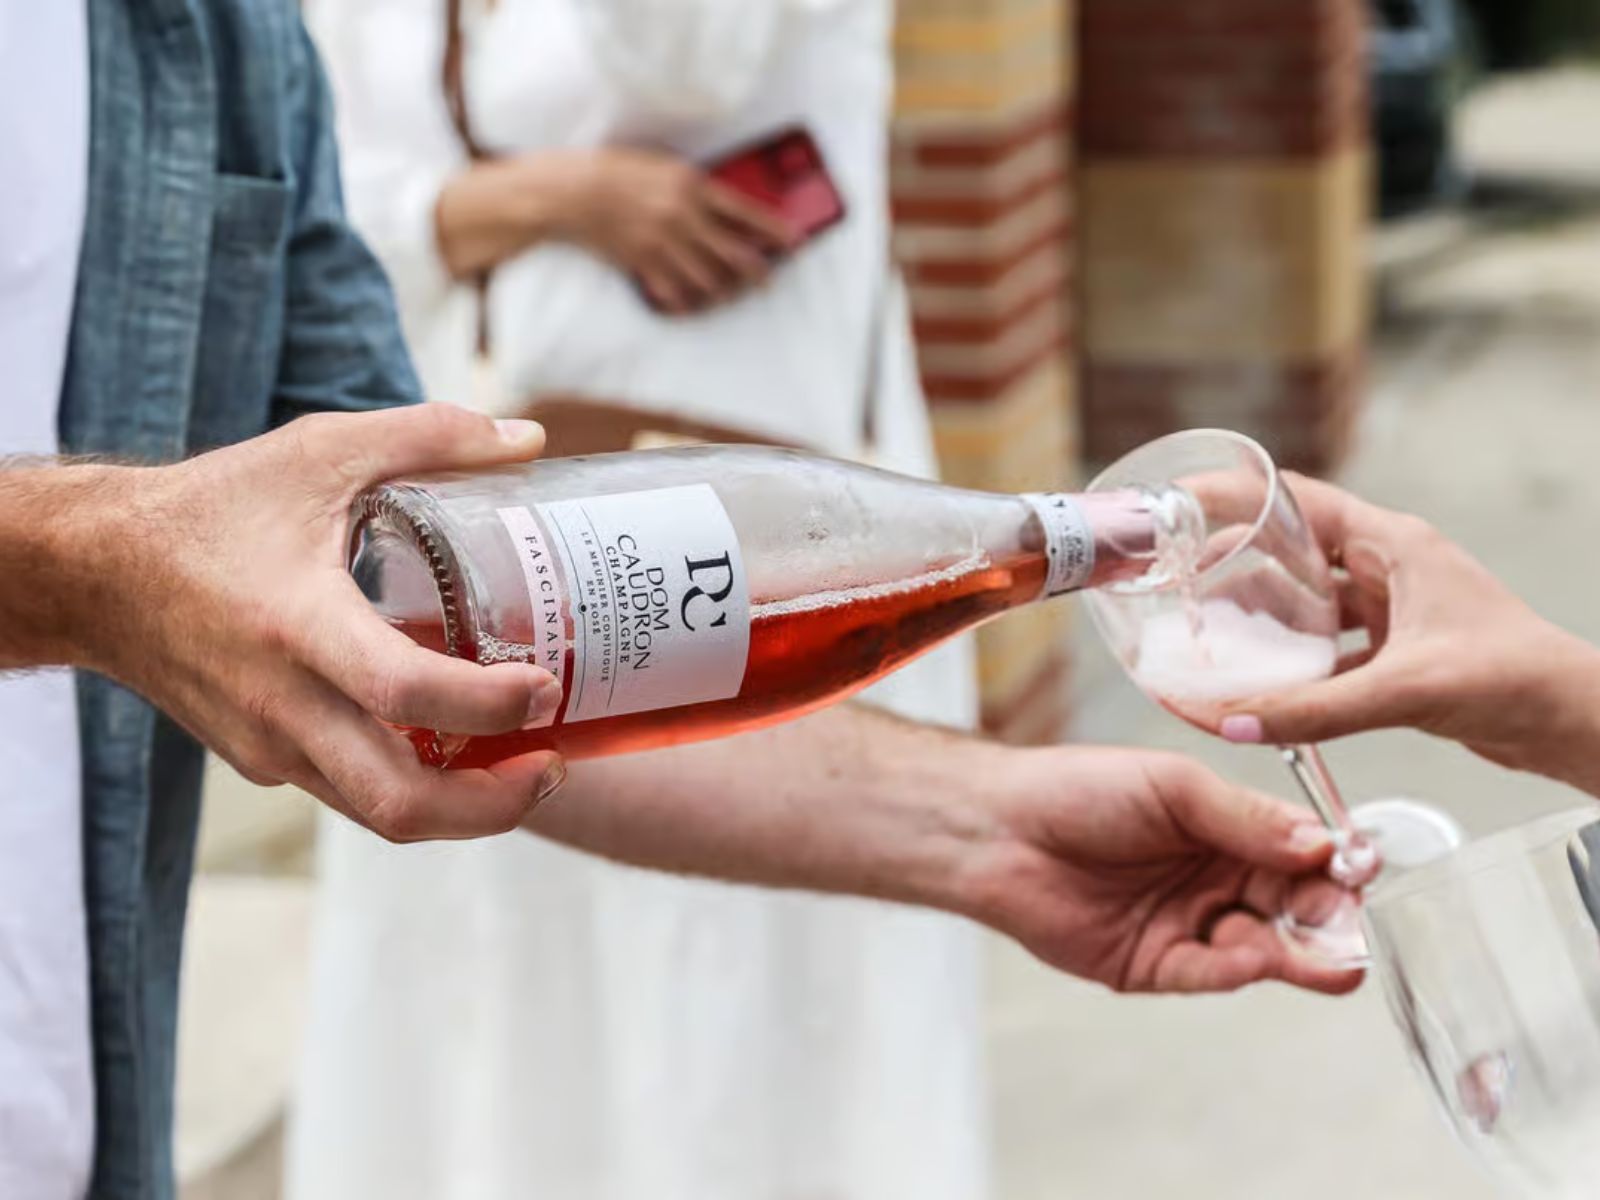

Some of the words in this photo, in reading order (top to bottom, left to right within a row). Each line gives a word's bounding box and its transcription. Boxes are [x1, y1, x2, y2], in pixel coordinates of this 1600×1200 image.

[581, 531, 592, 546] LE
[589, 551, 609, 609] MEUNIER
[586, 580, 596, 596] EN
[606, 546, 631, 663] CHAMPAGNE
[617, 534, 651, 670] CAUDRON
[646, 567, 669, 630] DOM
[680, 550, 734, 632] DC
